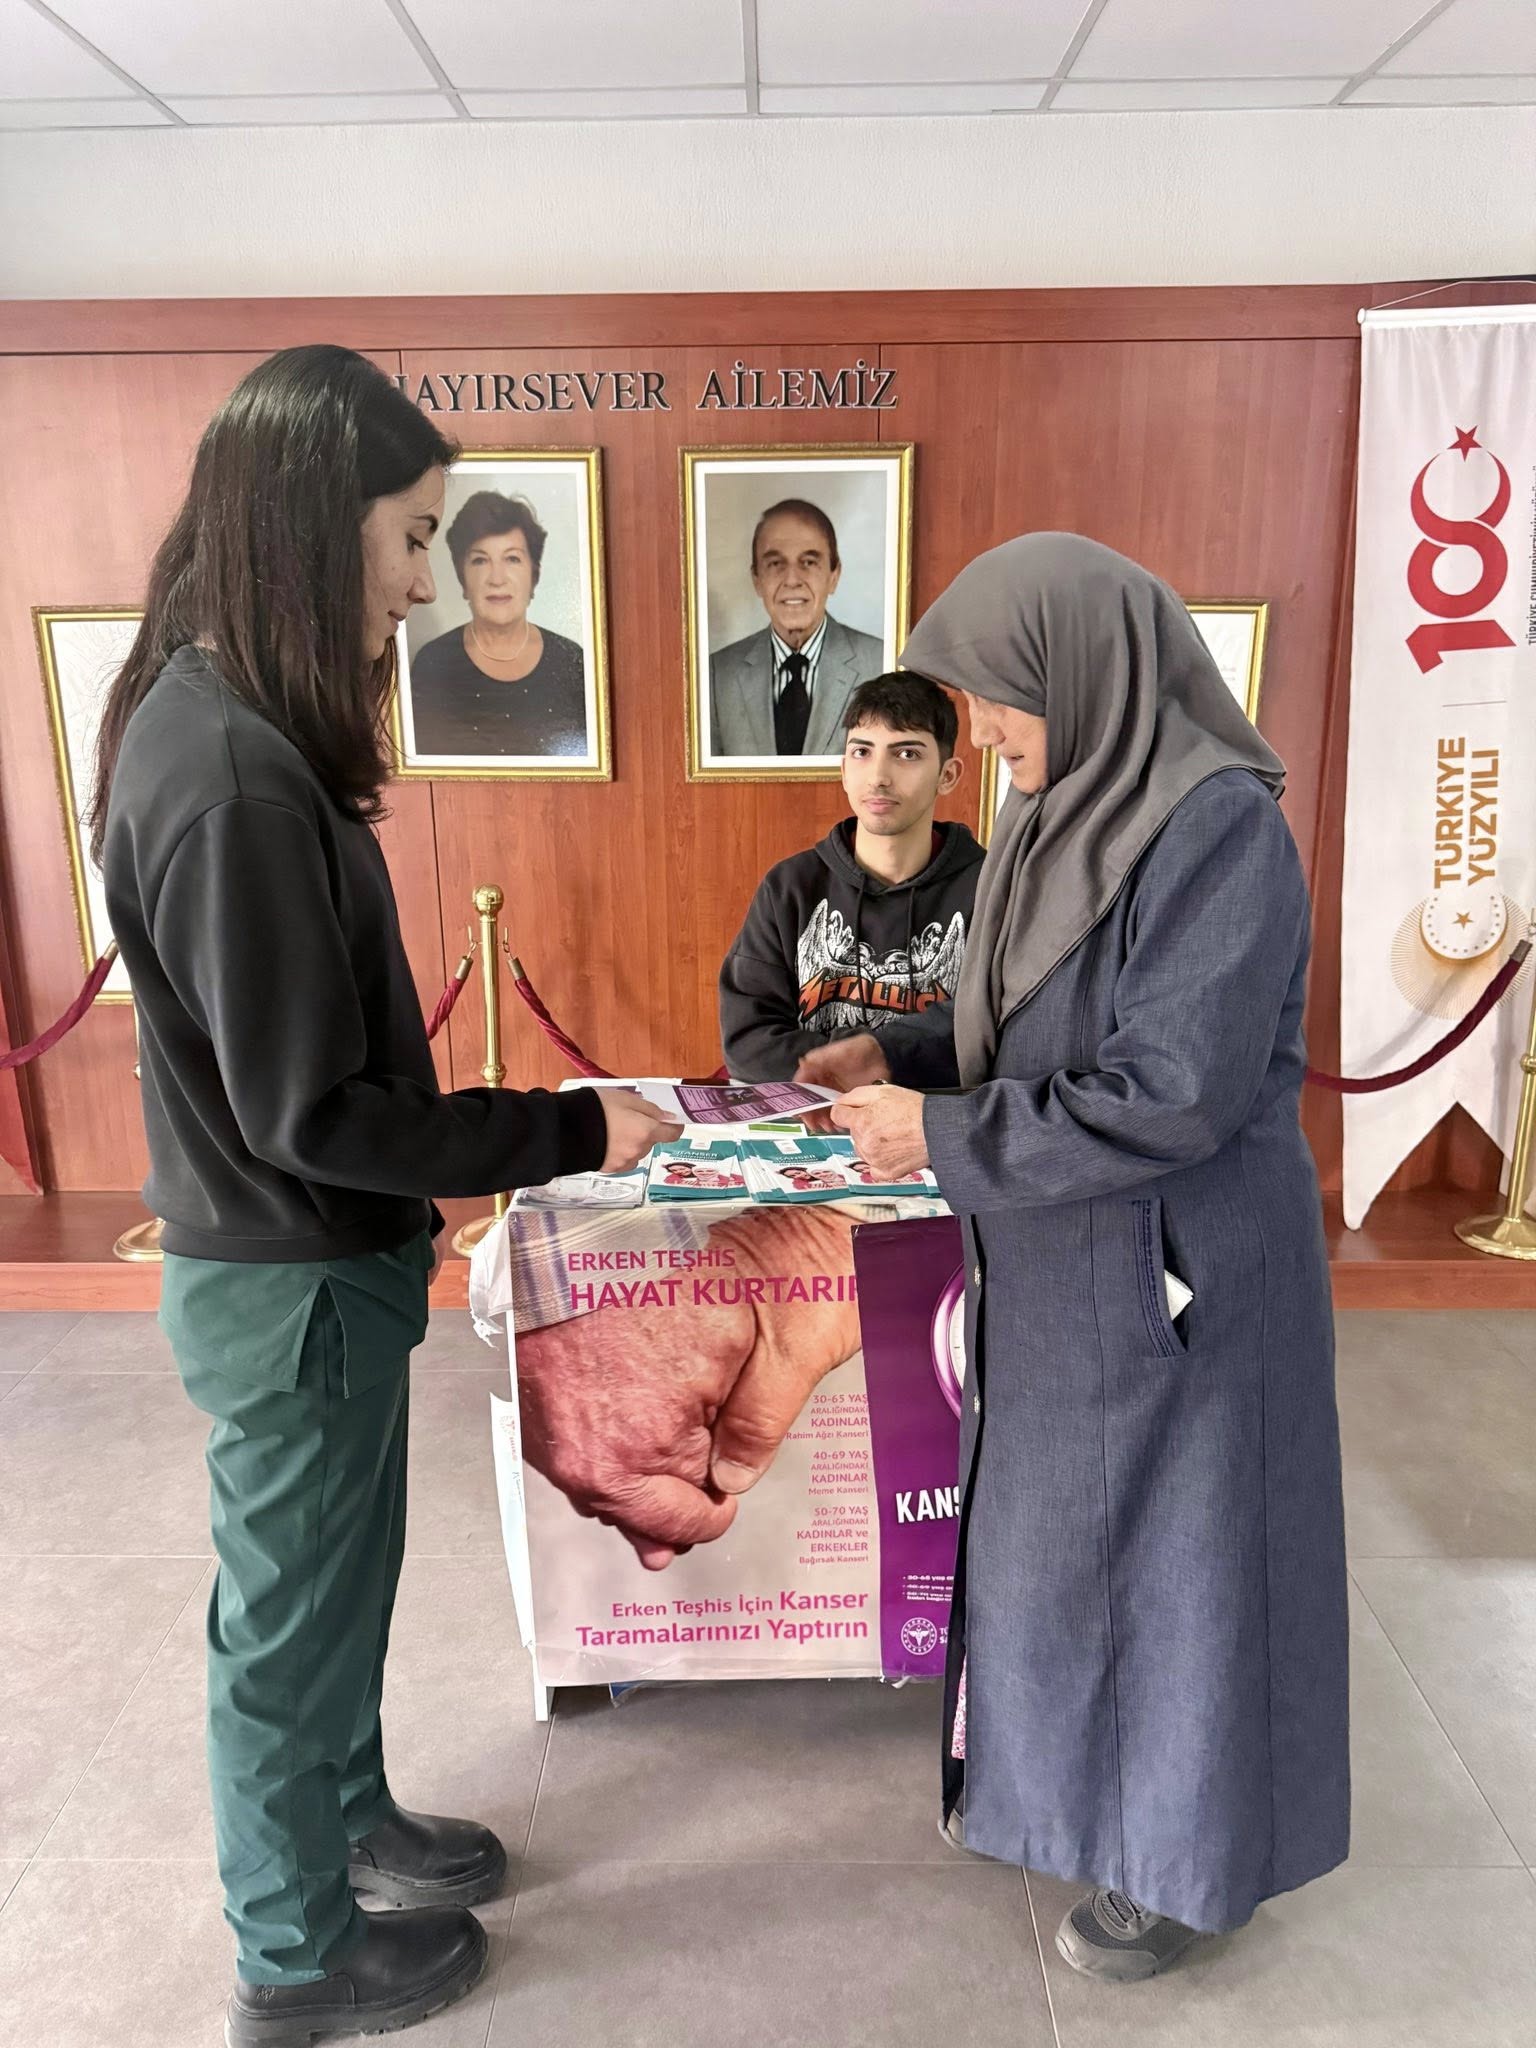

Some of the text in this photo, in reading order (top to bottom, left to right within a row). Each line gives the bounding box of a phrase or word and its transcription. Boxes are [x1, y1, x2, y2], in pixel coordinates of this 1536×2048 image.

[696, 360, 898, 409] AİLEMİZ
[568, 1249, 735, 1272] ERKEN TEŞHİS
[570, 1279, 677, 1310] HAYAT
[813, 1394, 845, 1404] 30-65
[811, 1417, 868, 1427] KADINLAR
[786, 1432, 813, 1440] Rahim
[836, 1430, 868, 1438] Kanseri
[813, 1451, 868, 1460] 40-69 YAŞ
[811, 1462, 868, 1471] ARALIĞINDAKİ
[811, 1473, 868, 1483] KADINLAR
[836, 1485, 868, 1494] Kanseri
[814, 1506, 869, 1516] 50-70 YAŞ
[812, 1517, 868, 1527] ARALIĞINDAKİ
[797, 1529, 852, 1540] KADINLAR
[811, 1542, 868, 1552] ERKEKLER
[800, 1555, 868, 1565] Bağırsak Kanseri
[613, 1590, 869, 1618] Erken Teşhis İçin Kanser
[576, 1618, 868, 1647] Taramalarınızı Yaptırın
